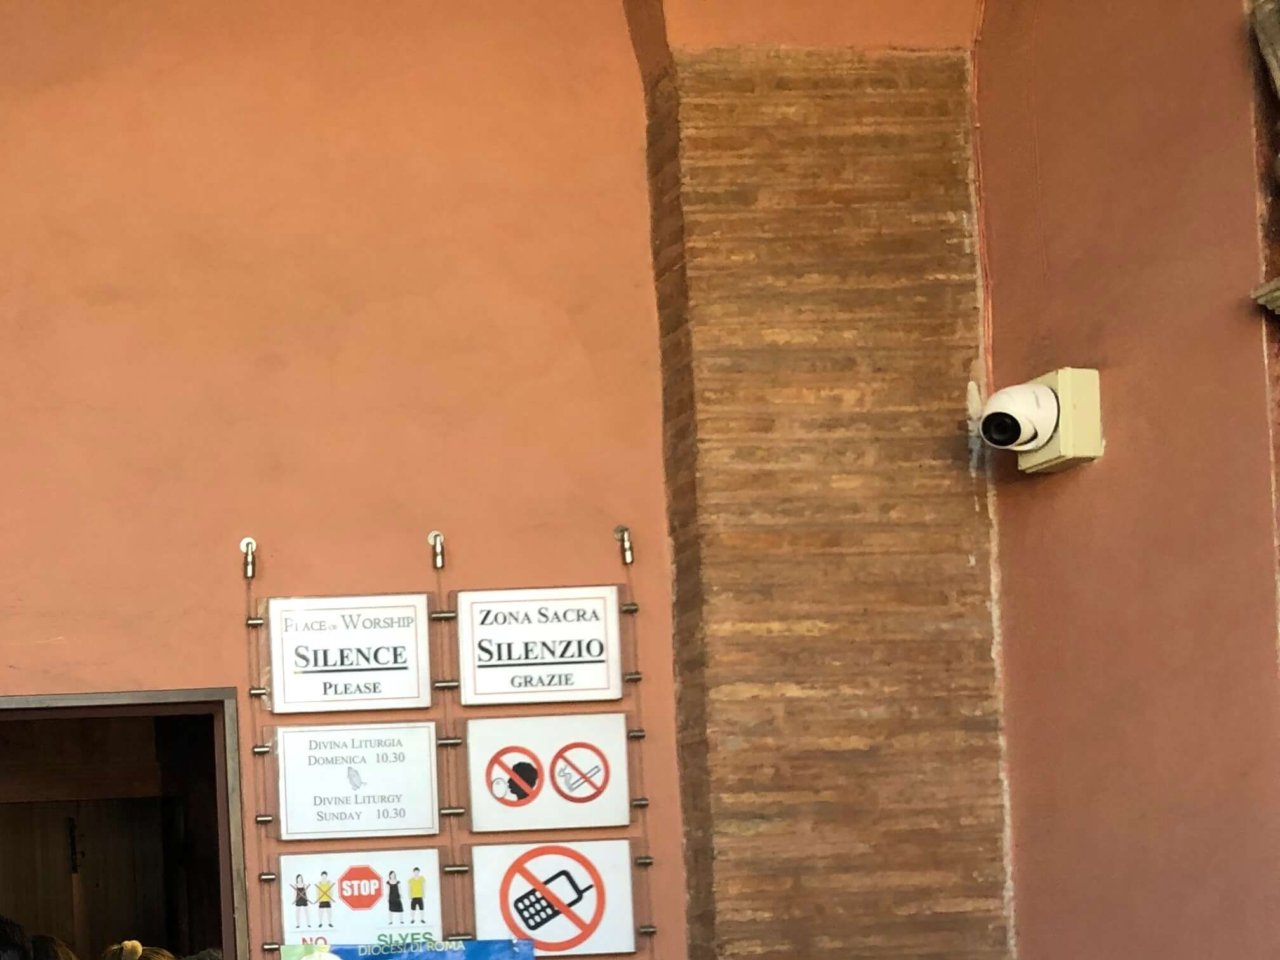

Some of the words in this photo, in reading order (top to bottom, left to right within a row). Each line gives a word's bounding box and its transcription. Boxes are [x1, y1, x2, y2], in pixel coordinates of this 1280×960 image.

[341, 614, 414, 631] WORSHIP
[479, 609, 532, 626] ZONA
[537, 607, 600, 623] SACRA
[294, 645, 408, 668] SILENCE
[477, 638, 605, 662] SILENZIO
[510, 673, 575, 688] GRAZIE
[323, 681, 382, 696] PLEASE
[309, 739, 348, 751] DIVINA
[351, 738, 403, 749] LITURGIA
[308, 755, 367, 766] DOMENICA
[375, 752, 405, 763] 10.30
[313, 795, 351, 806] DIVINE
[354, 794, 403, 805] LITURGY
[316, 811, 363, 822] SUNDAY
[376, 808, 406, 819] 10.30
[342, 880, 379, 897] STOP
